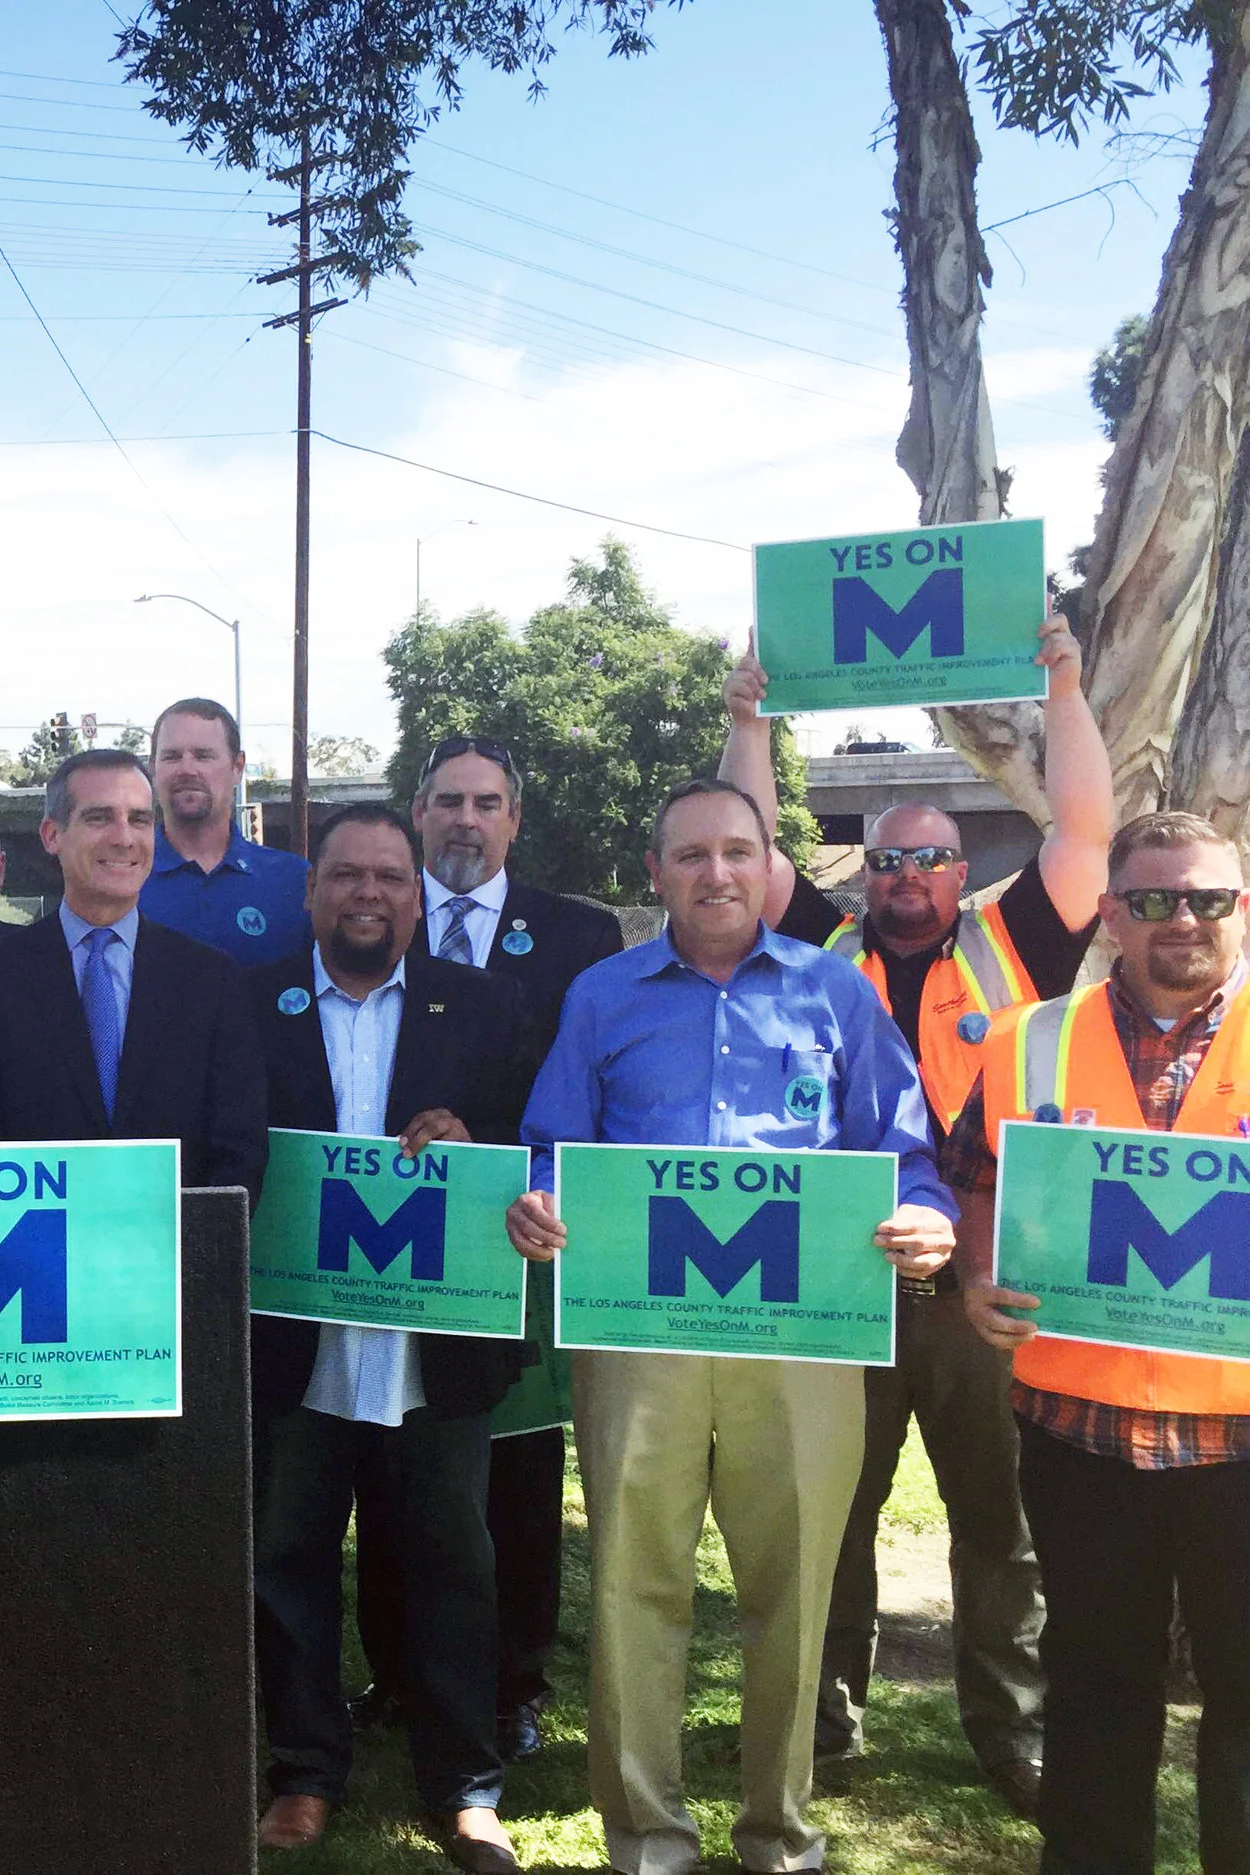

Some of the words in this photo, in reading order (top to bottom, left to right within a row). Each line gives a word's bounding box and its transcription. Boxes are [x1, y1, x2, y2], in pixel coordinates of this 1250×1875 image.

[830, 542, 893, 572] YES
[905, 536, 963, 566] ON
[833, 567, 964, 665] M
[322, 1145, 381, 1177] YES
[392, 1154, 449, 1182] ON
[646, 1159, 720, 1191] YES
[734, 1162, 801, 1194] ON
[1092, 1141, 1170, 1177] YES
[1185, 1150, 1250, 1184] ON
[317, 1177, 447, 1281] M
[1087, 1178, 1250, 1301] M
[648, 1195, 800, 1304] M
[289, 1271, 329, 1284] ANGELES
[332, 1276, 372, 1288] COUNTY
[374, 1281, 415, 1293] TRAFFIC
[418, 1285, 490, 1298] IMPROVEMENT
[493, 1290, 519, 1300] PLAN
[331, 1289, 425, 1311] VoteYesOnM.org
[1024, 1281, 1047, 1293] LOS
[1050, 1285, 1102, 1299] ANGELES
[1105, 1291, 1157, 1306] COUNTY
[1160, 1297, 1213, 1313] TRAFFIC
[564, 1297, 585, 1308] THE
[590, 1299, 610, 1309] LOS
[613, 1300, 663, 1311] ANGELES
[667, 1302, 714, 1314] COUNTY
[717, 1305, 765, 1317] TRAFFIC
[769, 1308, 853, 1321] IMPROVEMENT
[856, 1312, 888, 1324] PLAN
[667, 1316, 778, 1336] VoteYesOnM.org
[32, 1349, 131, 1363] IMPROVEMENT
[136, 1348, 171, 1360] PLAN
